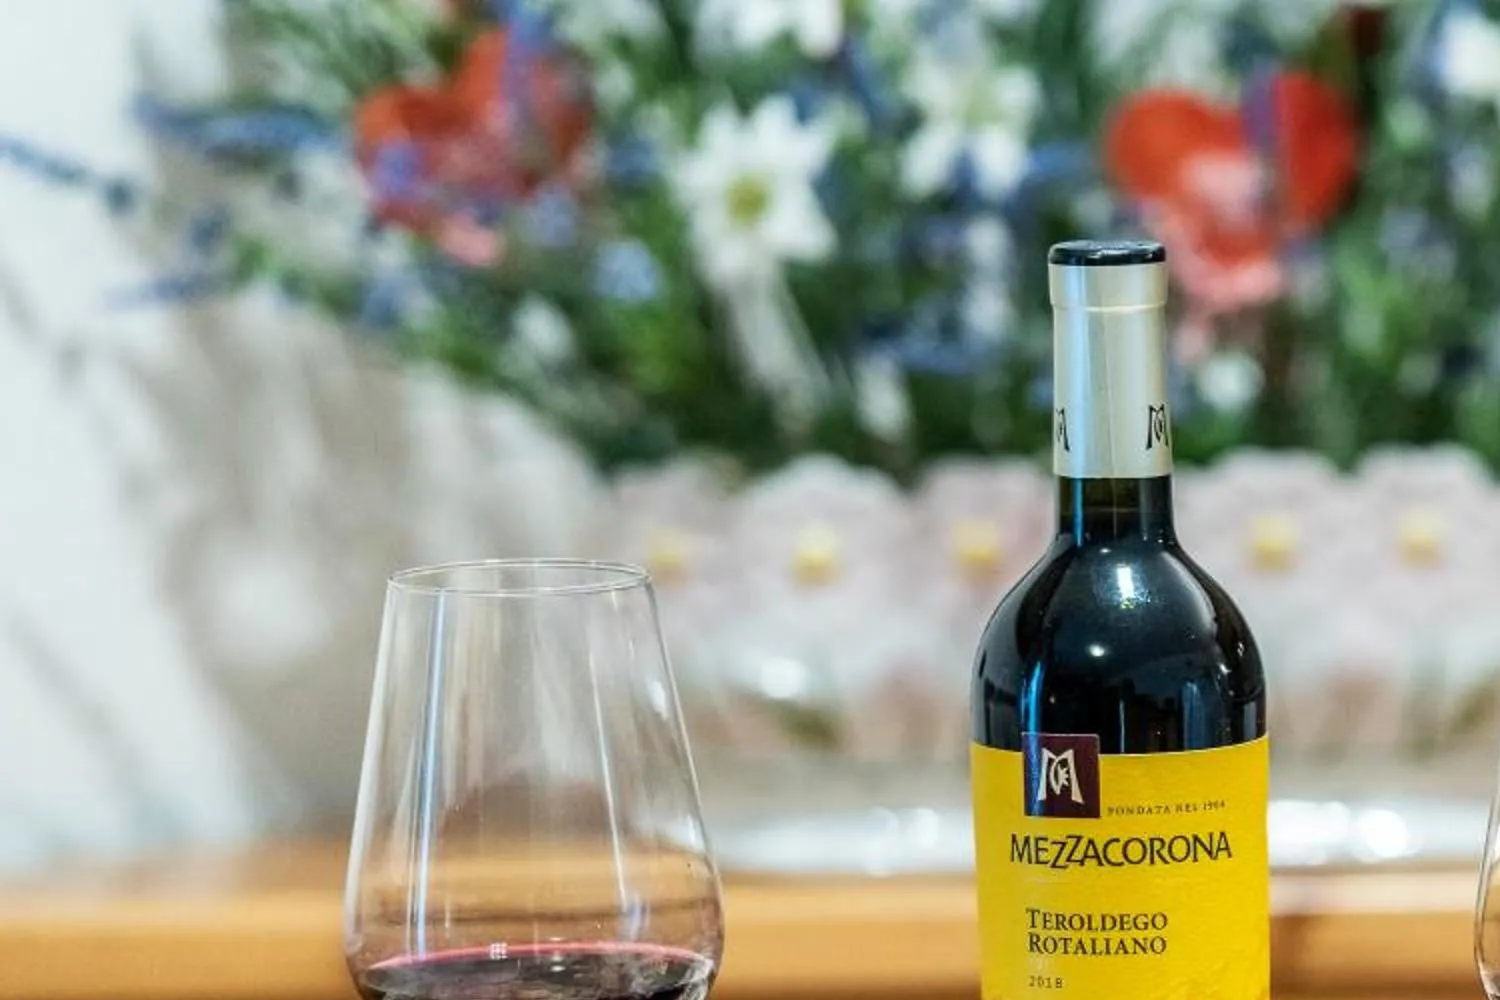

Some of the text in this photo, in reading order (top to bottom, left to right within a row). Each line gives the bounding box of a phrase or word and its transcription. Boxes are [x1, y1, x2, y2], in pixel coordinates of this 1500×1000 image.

[1106, 805, 1171, 817] FONDATA
[1175, 803, 1198, 813] NEL
[1009, 831, 1233, 870] MEZZACORONA
[1024, 907, 1169, 932] TEROLDEGO
[1027, 931, 1168, 957] ROTALIANO
[1028, 975, 1064, 990] 2018
